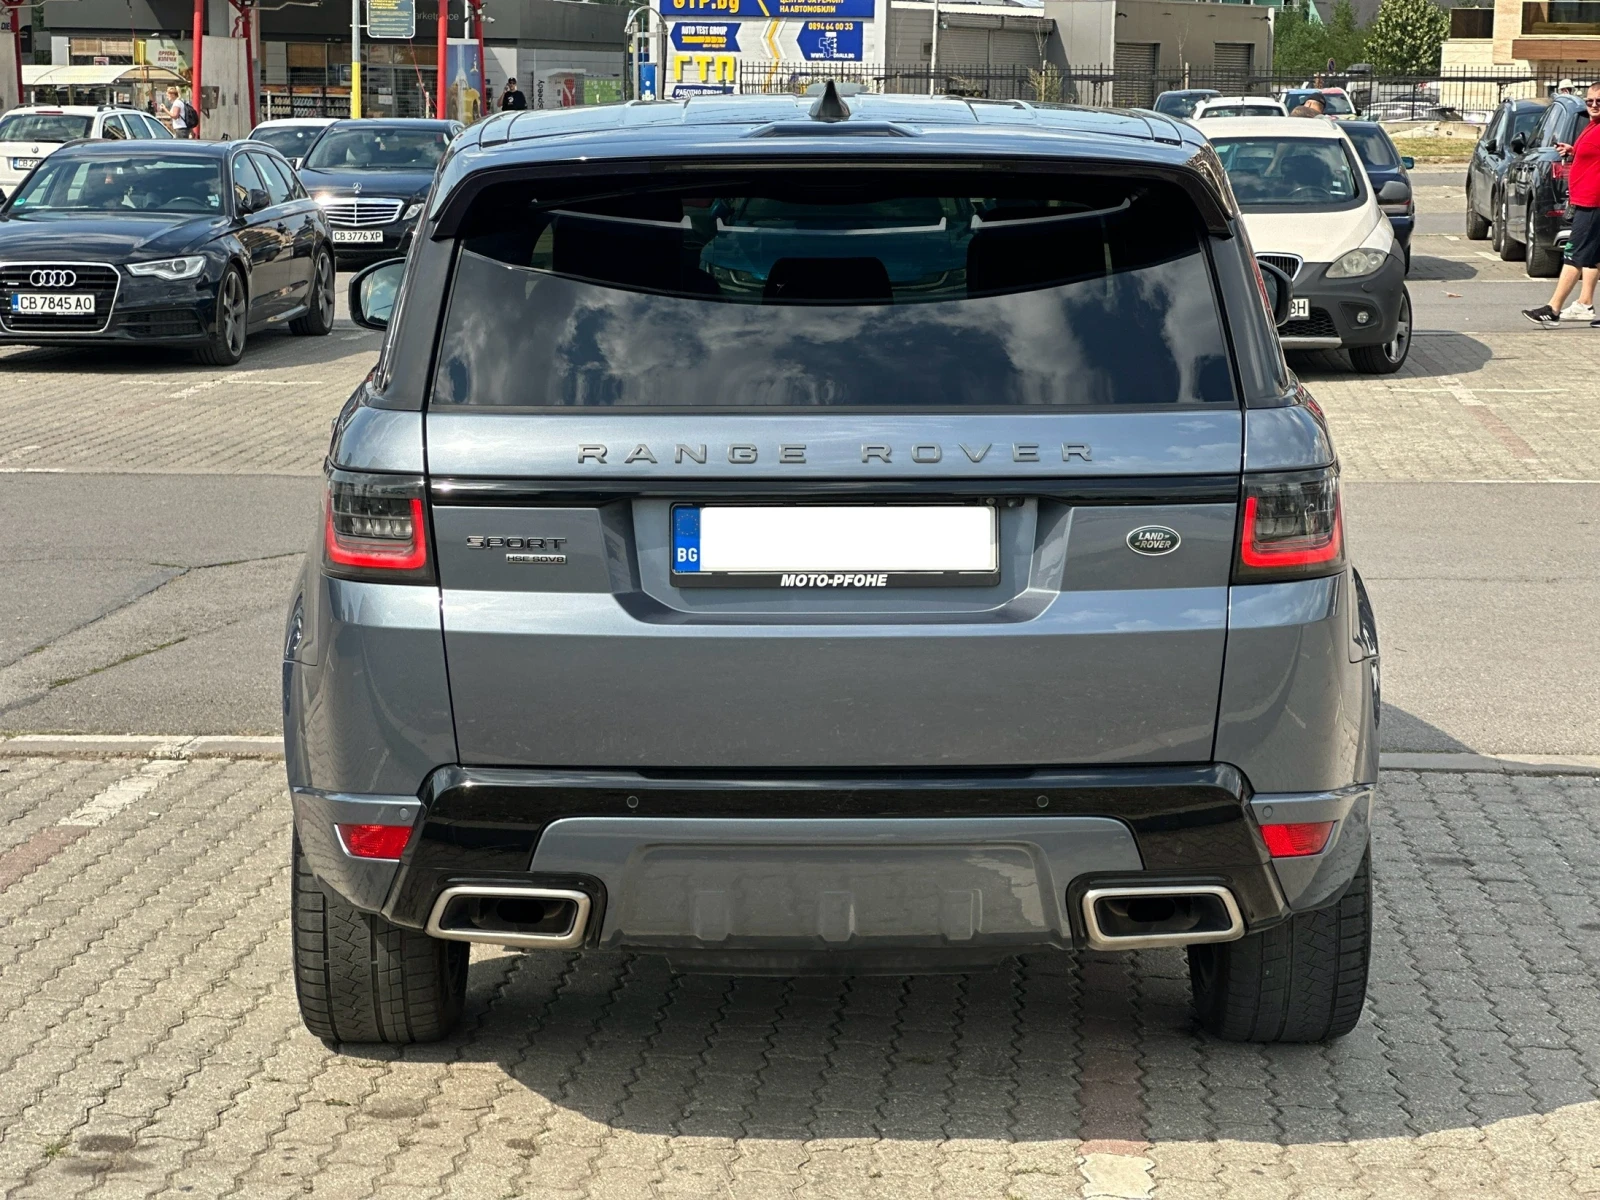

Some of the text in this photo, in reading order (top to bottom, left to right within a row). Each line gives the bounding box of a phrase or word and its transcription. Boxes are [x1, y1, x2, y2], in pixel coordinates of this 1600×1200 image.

[780, 5, 836, 13] НА АВТОМОБИЛИ
[696, 26, 709, 35] TEST
[808, 22, 854, 31] 0894 64 00 33
[674, 56, 734, 81] ГТП
[334, 231, 382, 241] CB 3776 XP
[20, 296, 37, 310] CB
[40, 297, 72, 310] 7845
[577, 442, 1092, 464] RANGE ROVER
[466, 535, 567, 550] SPORT
[1140, 540, 1172, 548] ROVER
[677, 547, 698, 562] BG
[780, 573, 888, 587] MOTO-PFOHE
